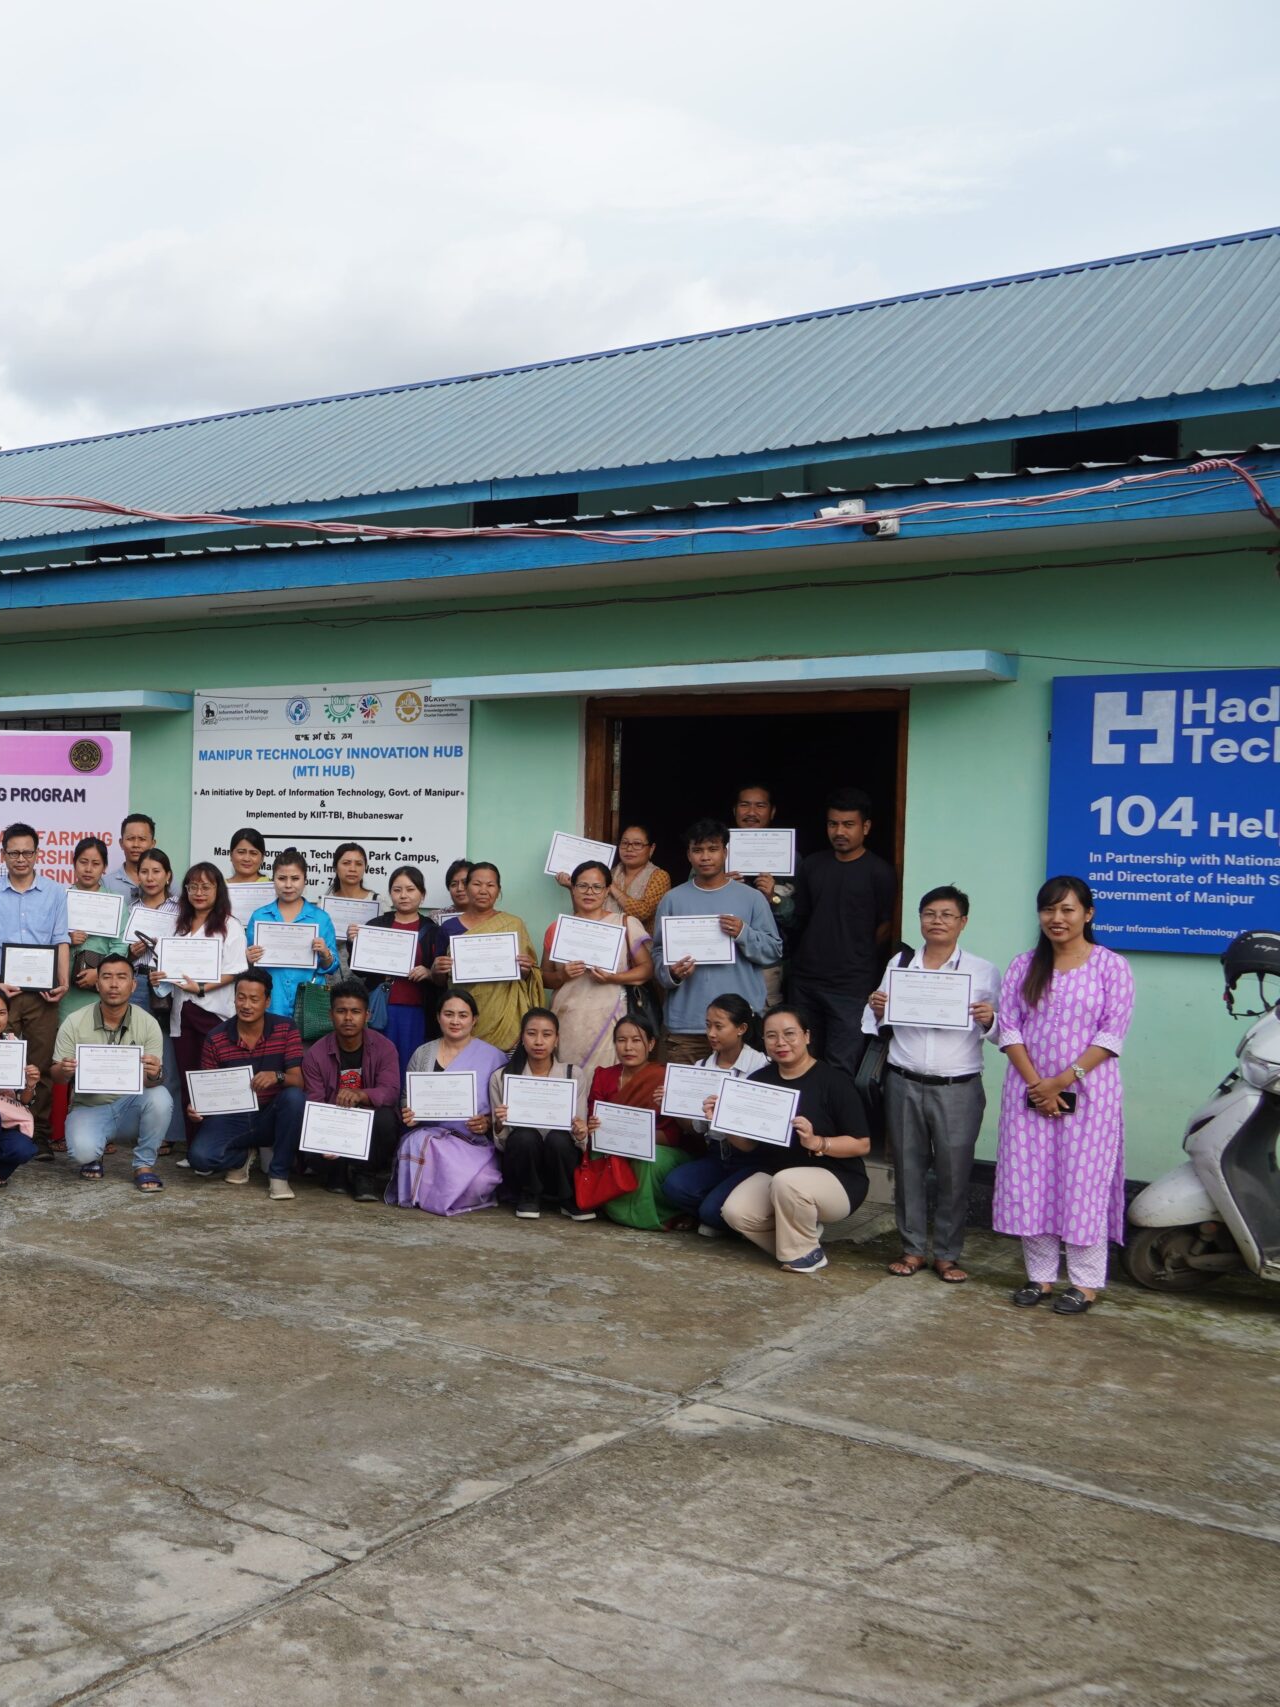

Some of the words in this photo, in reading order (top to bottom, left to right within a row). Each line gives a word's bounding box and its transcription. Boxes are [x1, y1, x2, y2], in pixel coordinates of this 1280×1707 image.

[1182, 685, 1280, 725] Had
[198, 750, 253, 761] MANIPUR
[256, 748, 343, 760] TECHNOLOGY
[346, 746, 429, 759] INNOVATION
[433, 745, 464, 758] HUB
[292, 765, 320, 778] (MTI
[322, 765, 355, 778] HUB)
[10, 788, 86, 803] PROGRAM
[211, 788, 243, 796] initiative
[245, 789, 254, 798] by
[256, 789, 276, 798] Dept.
[278, 788, 287, 796] of
[288, 788, 335, 796] Information
[337, 788, 386, 798] Technology,
[388, 788, 411, 797] Govt.
[413, 788, 422, 796] of
[424, 788, 460, 798] Manipur
[246, 810, 296, 820] Implemented
[298, 811, 308, 820] by
[347, 811, 404, 821] Bhubaneswar
[1090, 795, 1198, 837] 104
[1209, 809, 1280, 846] Hel
[368, 851, 391, 861] Park
[394, 852, 439, 864] Campus,
[1089, 852, 1102, 863] In
[1105, 852, 1187, 868] Partnership
[1190, 853, 1221, 866] with
[1088, 870, 1114, 881] and
[1117, 870, 1194, 884] Directorate
[1197, 872, 1214, 885] of
[1216, 873, 1265, 886] Health
[1090, 888, 1172, 902] Government
[1175, 890, 1191, 902] of
[1194, 891, 1255, 906] Manipur
[1126, 924, 1180, 935] Information
[1182, 926, 1238, 939] Technology
